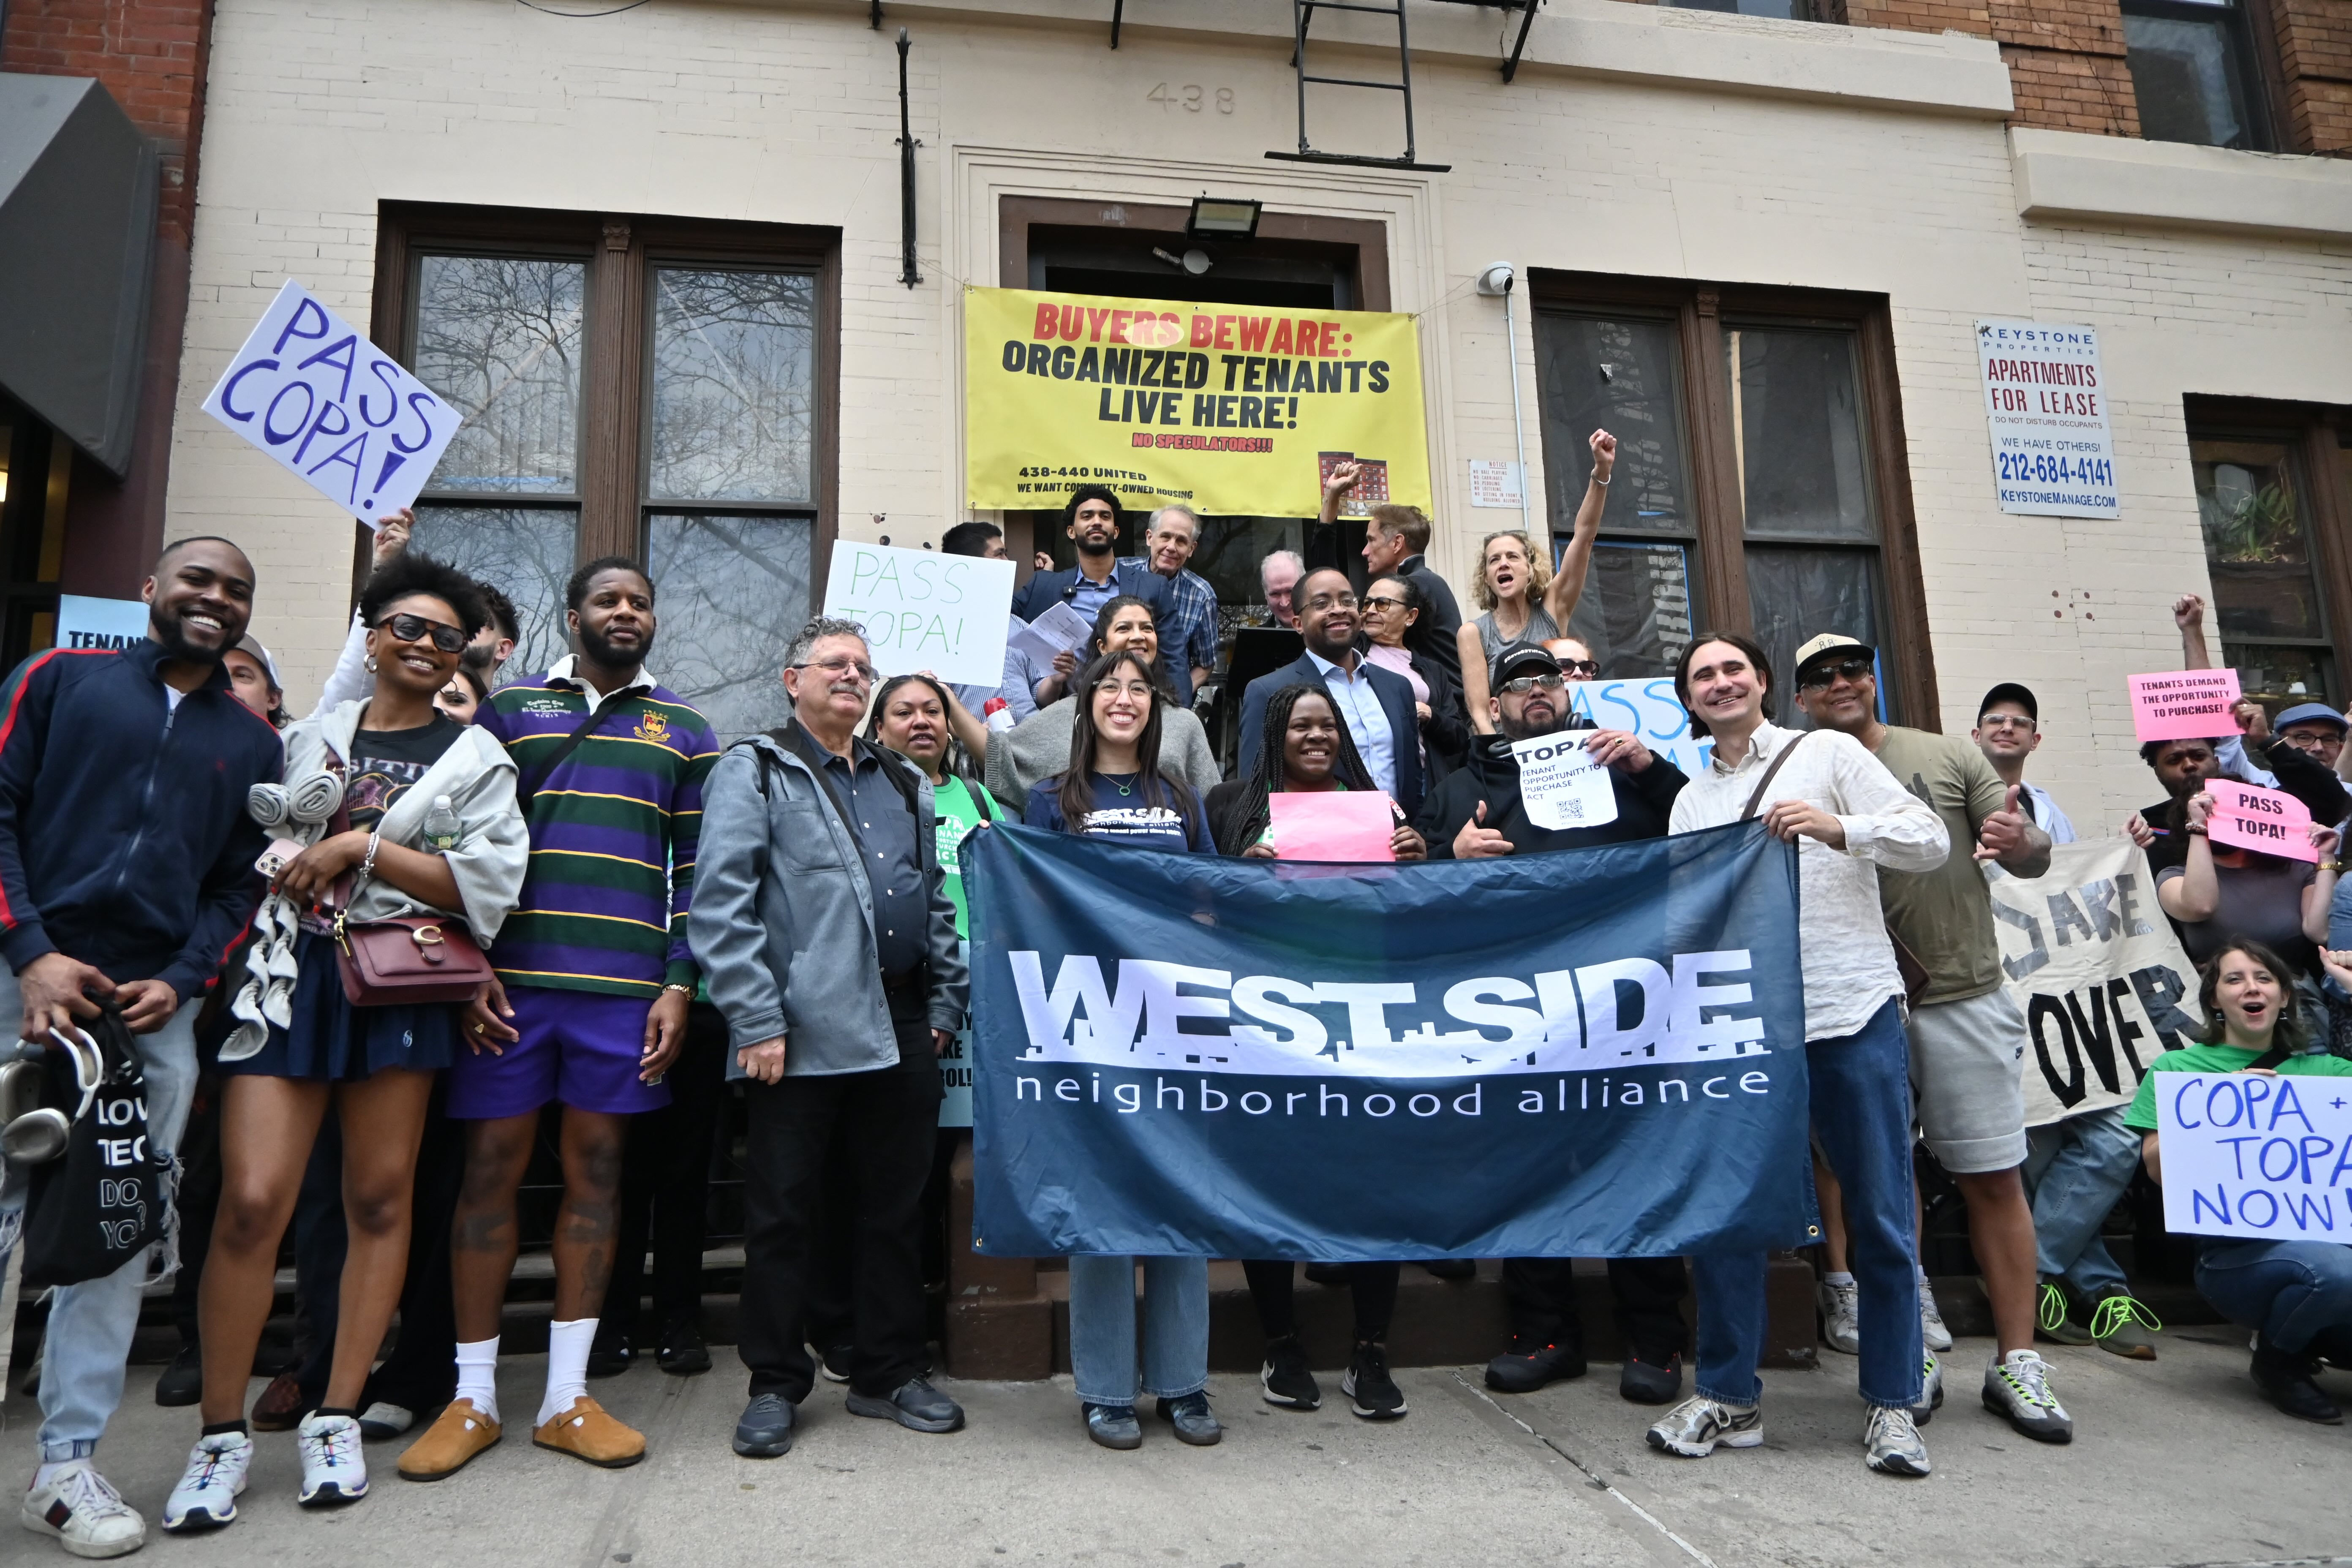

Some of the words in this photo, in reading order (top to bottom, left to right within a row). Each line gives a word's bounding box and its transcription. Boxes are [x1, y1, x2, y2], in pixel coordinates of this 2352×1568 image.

[1146, 82, 1237, 115] 438
[1033, 302, 1181, 348] BUYERS
[1189, 314, 1353, 357] BEWARE:
[1981, 326, 2093, 345] KEYSTONE
[1984, 341, 2093, 355] PROPERTIES
[273, 297, 436, 454] PASS
[1002, 340, 1209, 389] ORGANIZED
[1220, 356, 1390, 394] TENANTS
[1988, 359, 2096, 387] APARTMENTS
[1098, 387, 1182, 425] LIVE
[1192, 394, 1298, 430] HERE!
[1991, 388, 2027, 411] FOR
[2039, 391, 2098, 416] LEASE
[221, 359, 407, 509] COPA!
[2026, 418, 2057, 426] DISTURB
[2059, 420, 2102, 429] OCCUPANTS
[1131, 432, 1154, 448] NO
[1154, 433, 1273, 453] SPECULATORS!!!
[2001, 437, 2019, 448] WE
[2023, 439, 2052, 449] HAVE
[2056, 441, 2101, 453] OTHERS!
[1019, 466, 1089, 477] 438-440
[1093, 467, 1147, 481] UNITED
[1999, 452, 2112, 486] 212-684-4141
[1017, 483, 1031, 493] WE
[1034, 483, 1063, 492] WANT
[1156, 487, 1193, 500] HOUSING
[851, 552, 969, 604] PASS
[838, 608, 963, 655] TOPA!
[2141, 679, 2183, 691] TENANTS
[2186, 678, 2226, 687] DEMAND
[2142, 696, 2160, 705] THE
[2162, 690, 2230, 702] OPPORTUNITY
[2153, 709, 2167, 718] TO
[2168, 704, 2224, 717] PURCHASE!
[1522, 765, 1556, 777] TENANT
[1523, 766, 1586, 785] OPPORTUNITY
[1588, 763, 1601, 771] TO
[1525, 780, 1573, 792] PURCHASE
[2239, 793, 2283, 815] PASS
[2235, 817, 2286, 841] TOPA!
[2028, 964, 2208, 1109] OVER
[1016, 1072, 1481, 1118] neighborhood
[1518, 1071, 1770, 1113] alliance
[2175, 1078, 2315, 1133] COPA
